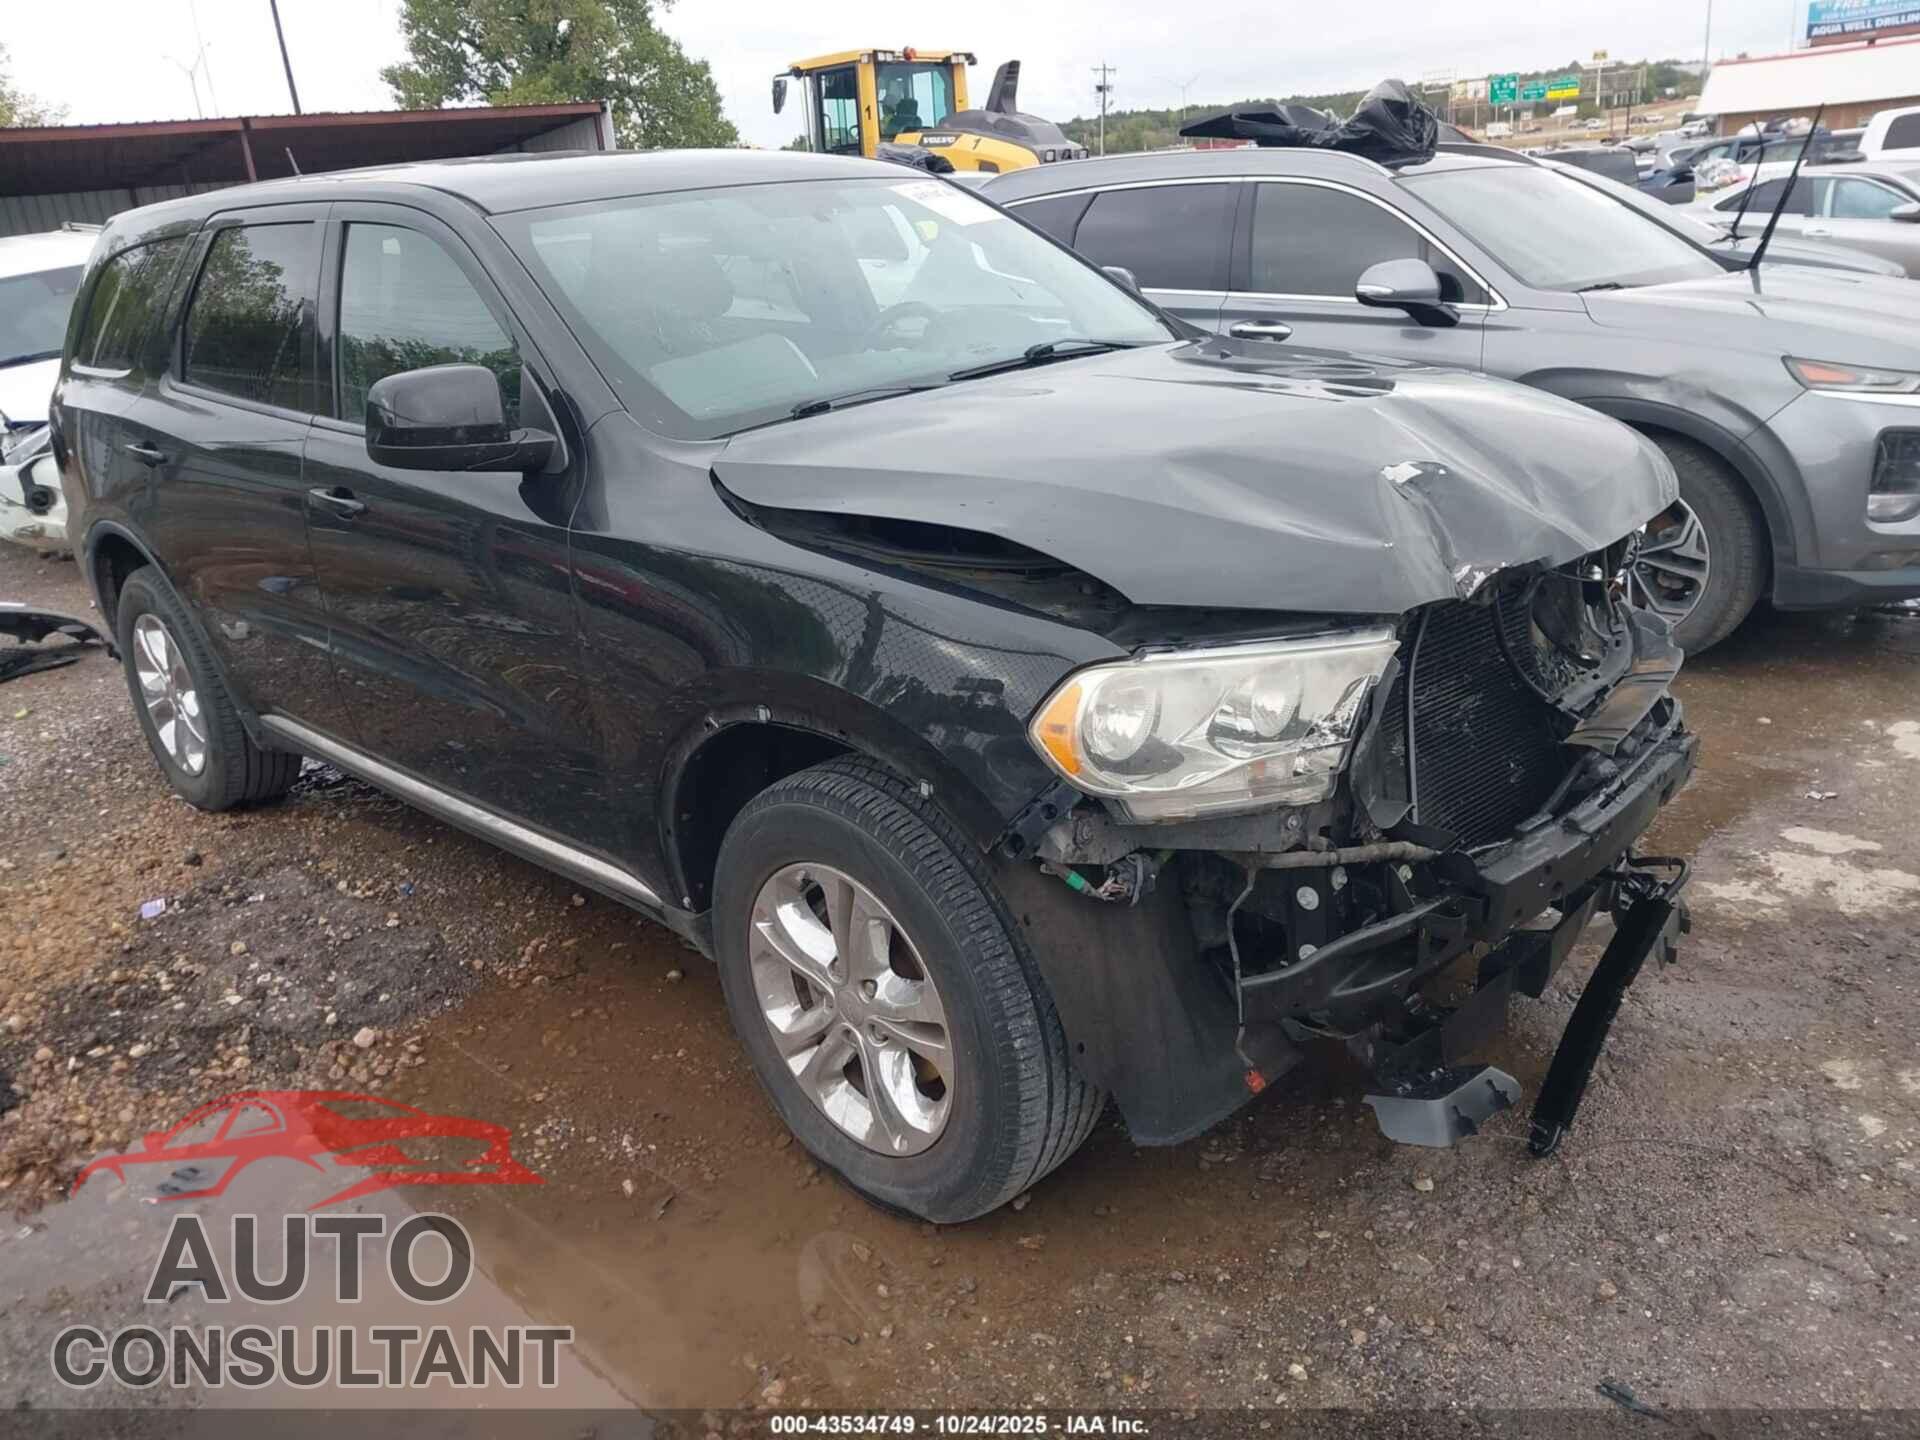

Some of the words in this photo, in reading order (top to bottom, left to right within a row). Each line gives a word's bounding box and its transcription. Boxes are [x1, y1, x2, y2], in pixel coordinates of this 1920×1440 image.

[1811, 24, 1842, 37] AQUA
[1843, 18, 1873, 33] WELL
[923, 136, 957, 144] VOLVO
